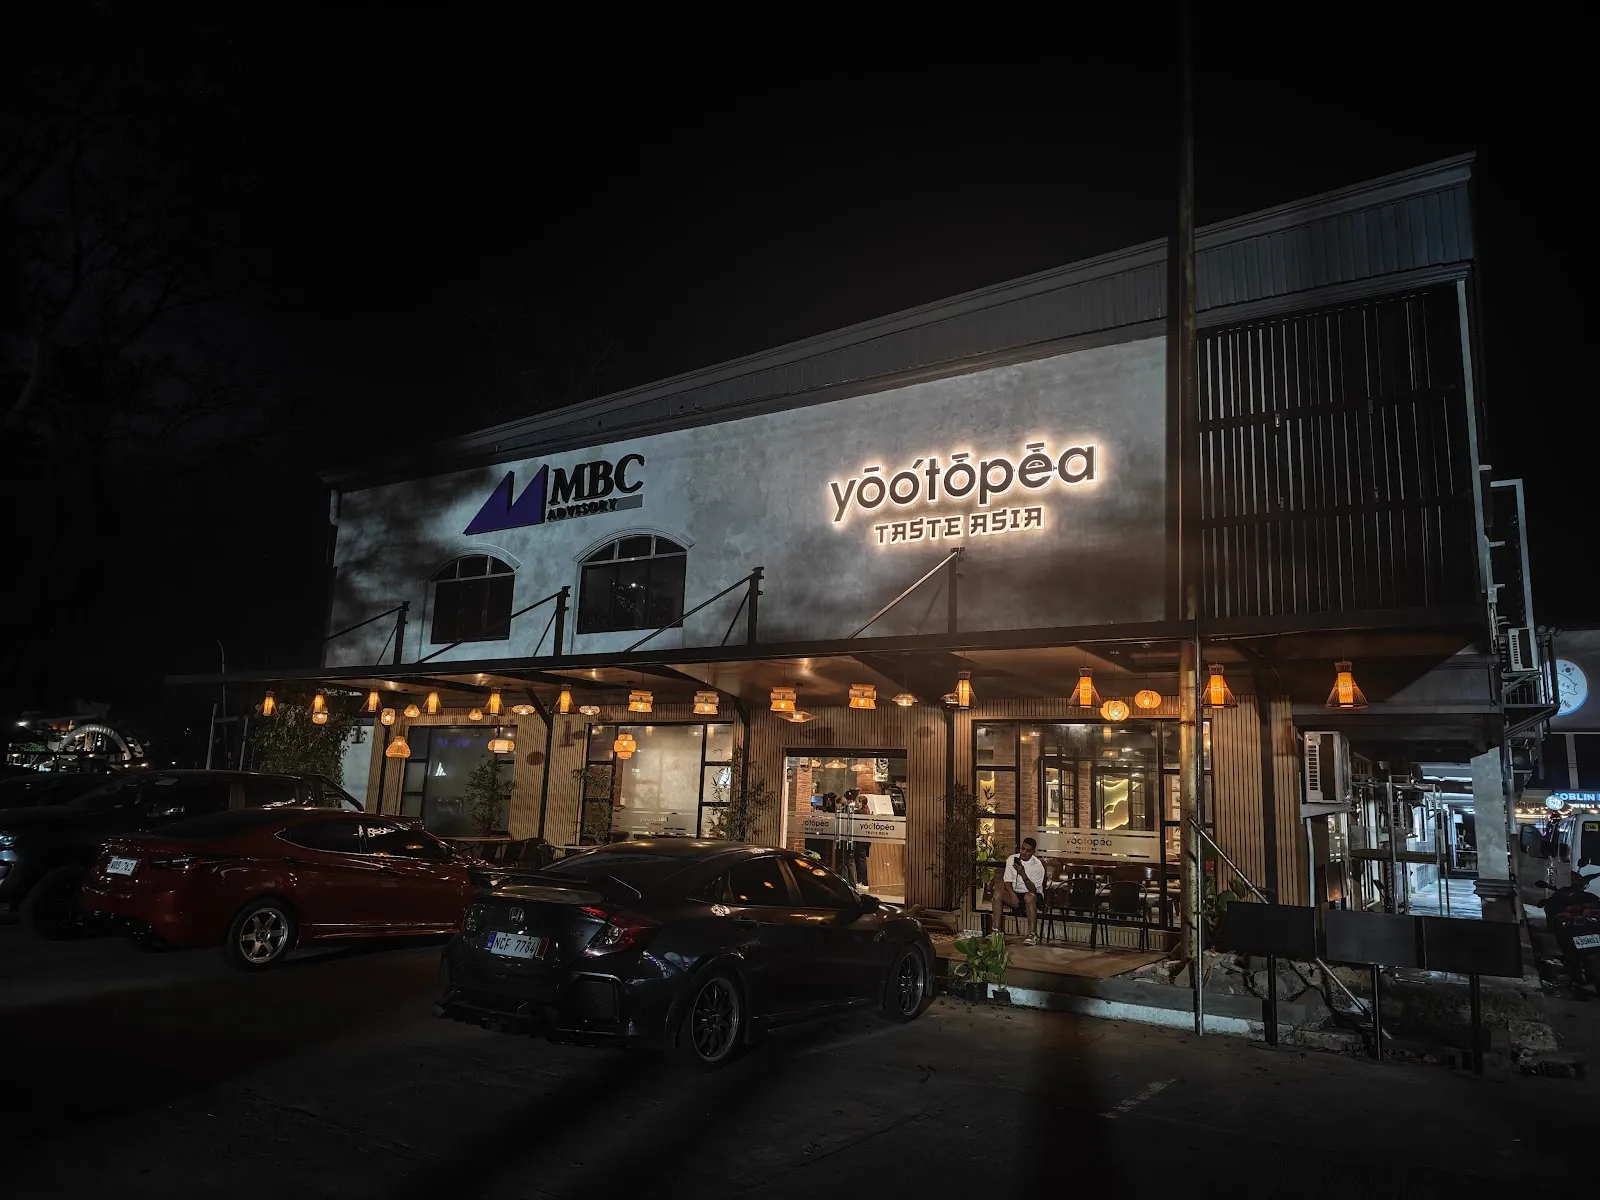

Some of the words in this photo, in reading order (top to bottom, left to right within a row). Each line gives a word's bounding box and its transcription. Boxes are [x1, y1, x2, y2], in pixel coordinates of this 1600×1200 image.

[547, 453, 645, 505] MBC
[546, 498, 619, 521] ADVISORY
[874, 516, 962, 544] TASTE
[969, 506, 1043, 536] ASIA
[1554, 792, 1596, 801] OBLIN
[494, 937, 511, 950] NCF
